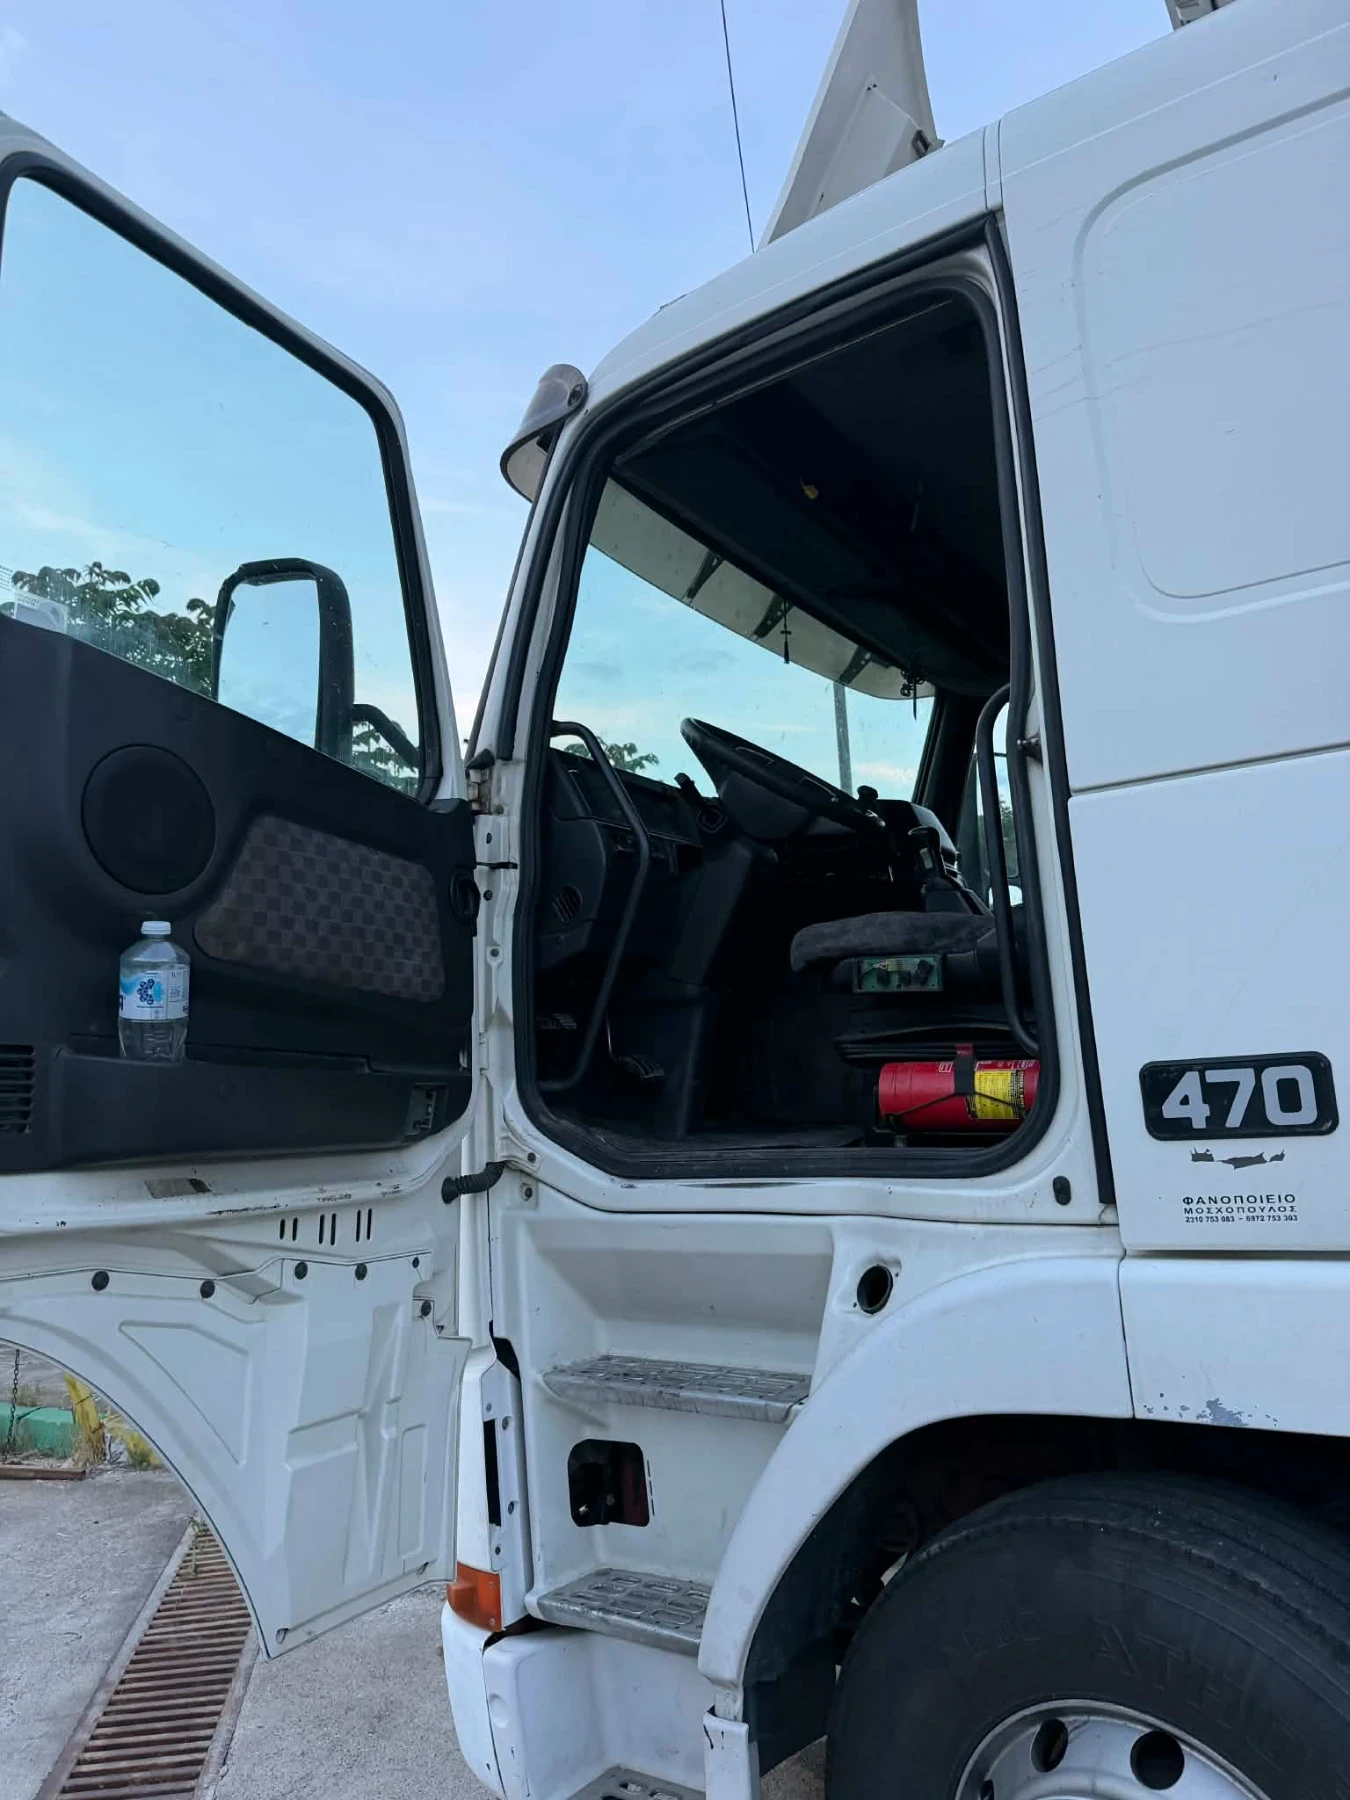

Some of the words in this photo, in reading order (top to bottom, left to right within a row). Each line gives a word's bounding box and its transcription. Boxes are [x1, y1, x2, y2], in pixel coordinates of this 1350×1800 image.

[1161, 1065, 1318, 1129] 470
[1182, 1193, 1296, 1205] ΦΑΝΟΠΟΙΕΙΟ
[1184, 1205, 1297, 1214] ΜΟΣΧΟΠΟΥΛΟΣ
[1185, 1215, 1204, 1223] 2310
[1206, 1215, 1219, 1223] 753
[1268, 1214, 1281, 1222] 753
